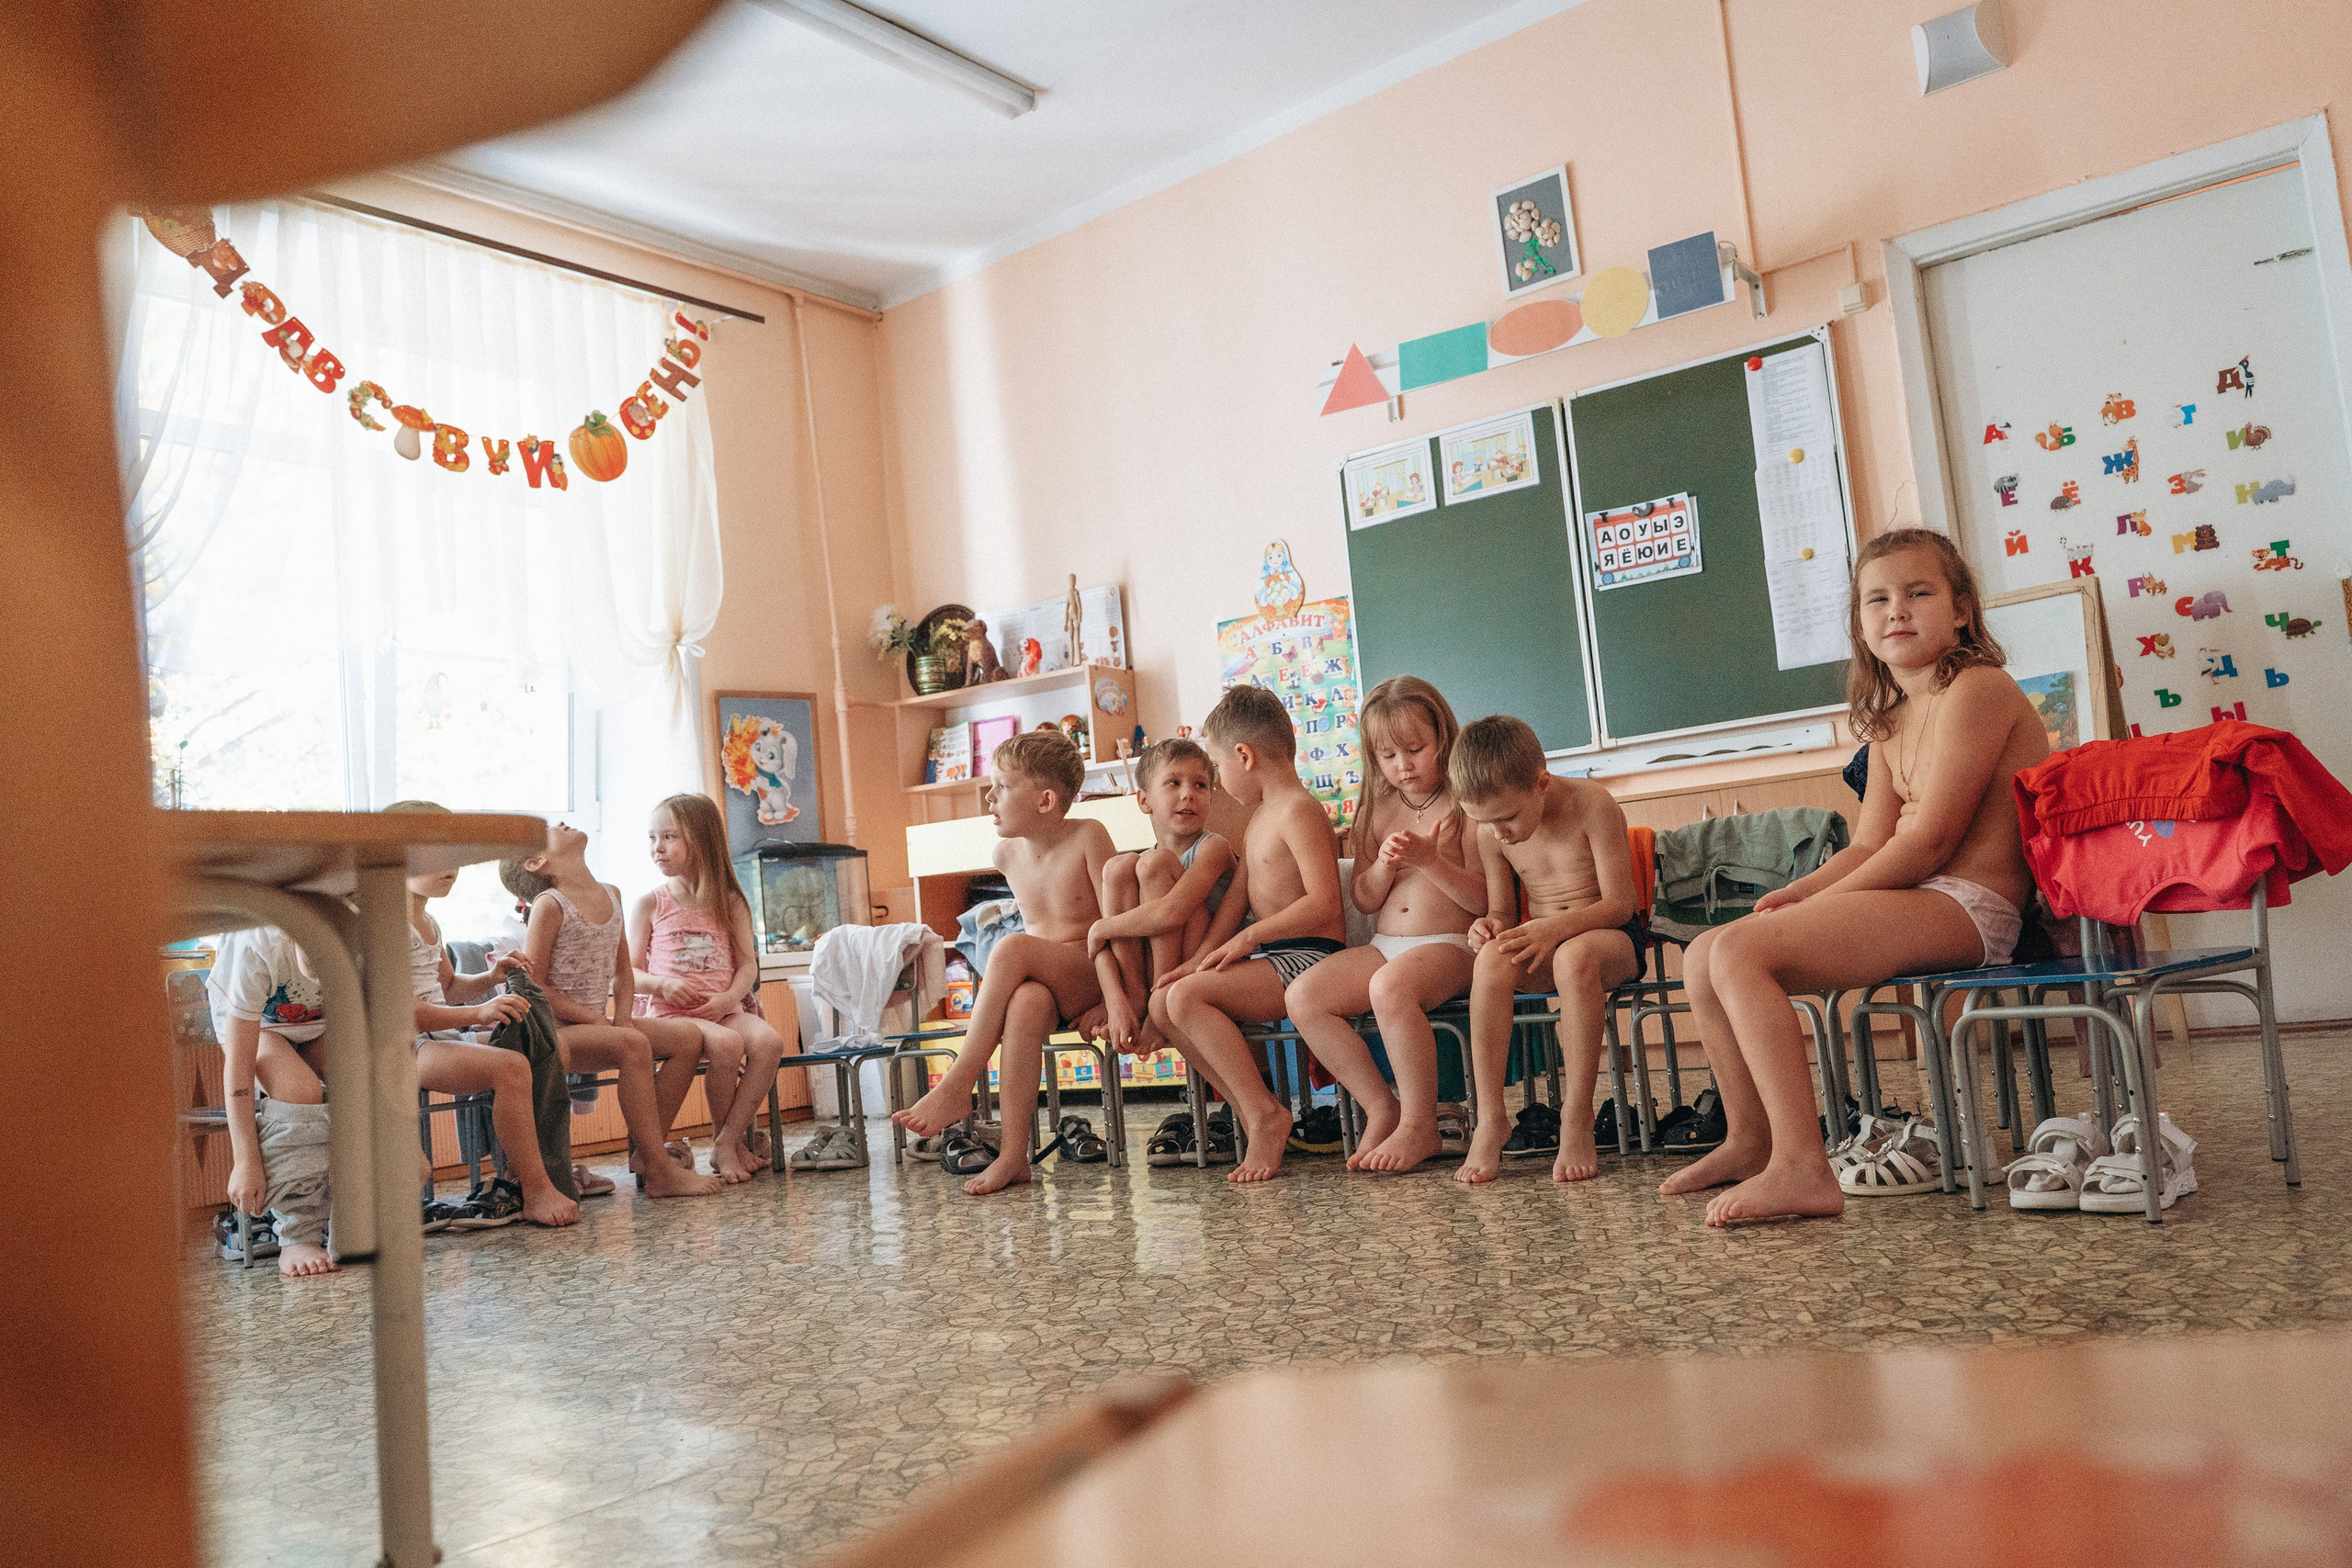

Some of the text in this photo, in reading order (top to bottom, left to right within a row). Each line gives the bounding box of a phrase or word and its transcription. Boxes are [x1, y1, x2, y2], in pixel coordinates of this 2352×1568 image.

[1984, 423, 2008, 445] А
[2115, 400, 2137, 421] В
[2216, 367, 2245, 394] Д
[2000, 427, 2247, 507] Е Ё Ж З И
[1601, 515, 1684, 544] А О У Ы Э
[1604, 538, 1687, 567] Я Ё Ю И Е
[2005, 529, 2029, 557] Й
[2069, 556, 2096, 579] К
[2127, 539, 2290, 617] Р С Т
[1240, 614, 1326, 645] АЛФАВИТ
[2136, 634, 2161, 657] Х
[2265, 612, 2290, 632] Ч
[1245, 636, 1313, 660] А Б В
[1278, 668, 1290, 682] Е
[1301, 661, 1313, 679] Ё
[1324, 658, 1342, 673] Ж
[1304, 692, 1317, 706] К
[1331, 688, 1344, 702] Л
[2154, 668, 2290, 723] Ъ Ы Ь
[1306, 715, 1347, 734] П Р
[1310, 743, 1350, 761] Ф Х
[1315, 771, 1360, 788] Щ Ъ
[1342, 799, 1354, 814] Я
